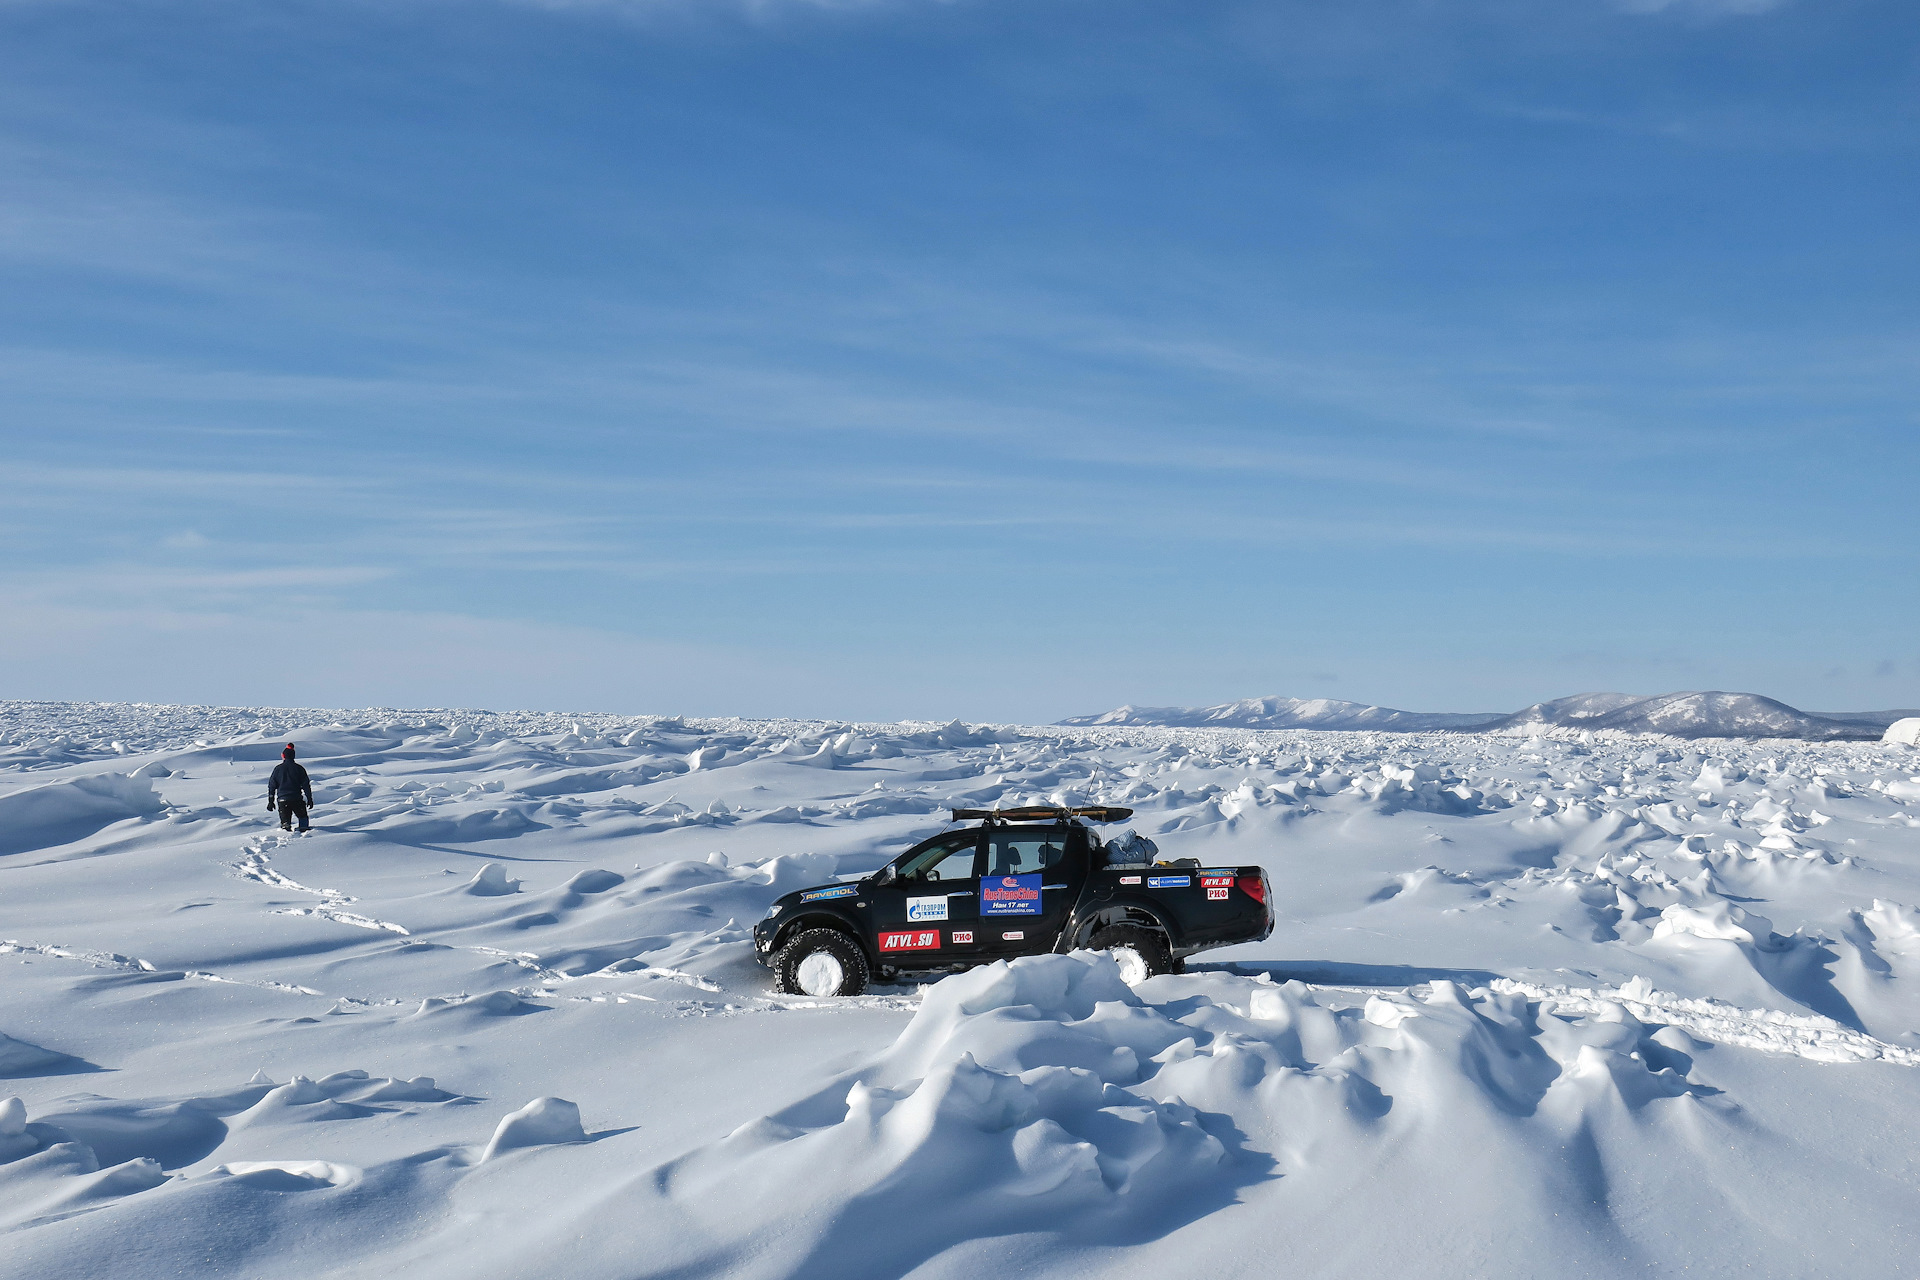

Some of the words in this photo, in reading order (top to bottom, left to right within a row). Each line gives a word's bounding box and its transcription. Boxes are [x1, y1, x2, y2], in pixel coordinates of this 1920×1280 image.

[1204, 878, 1230, 886] ATVL.SU
[806, 888, 854, 900] RAVENOL
[984, 888, 1038, 900] RusTransChina
[1209, 889, 1227, 898] РИФ
[884, 933, 934, 948] ATVL.SU
[953, 933, 972, 942] РИФ
